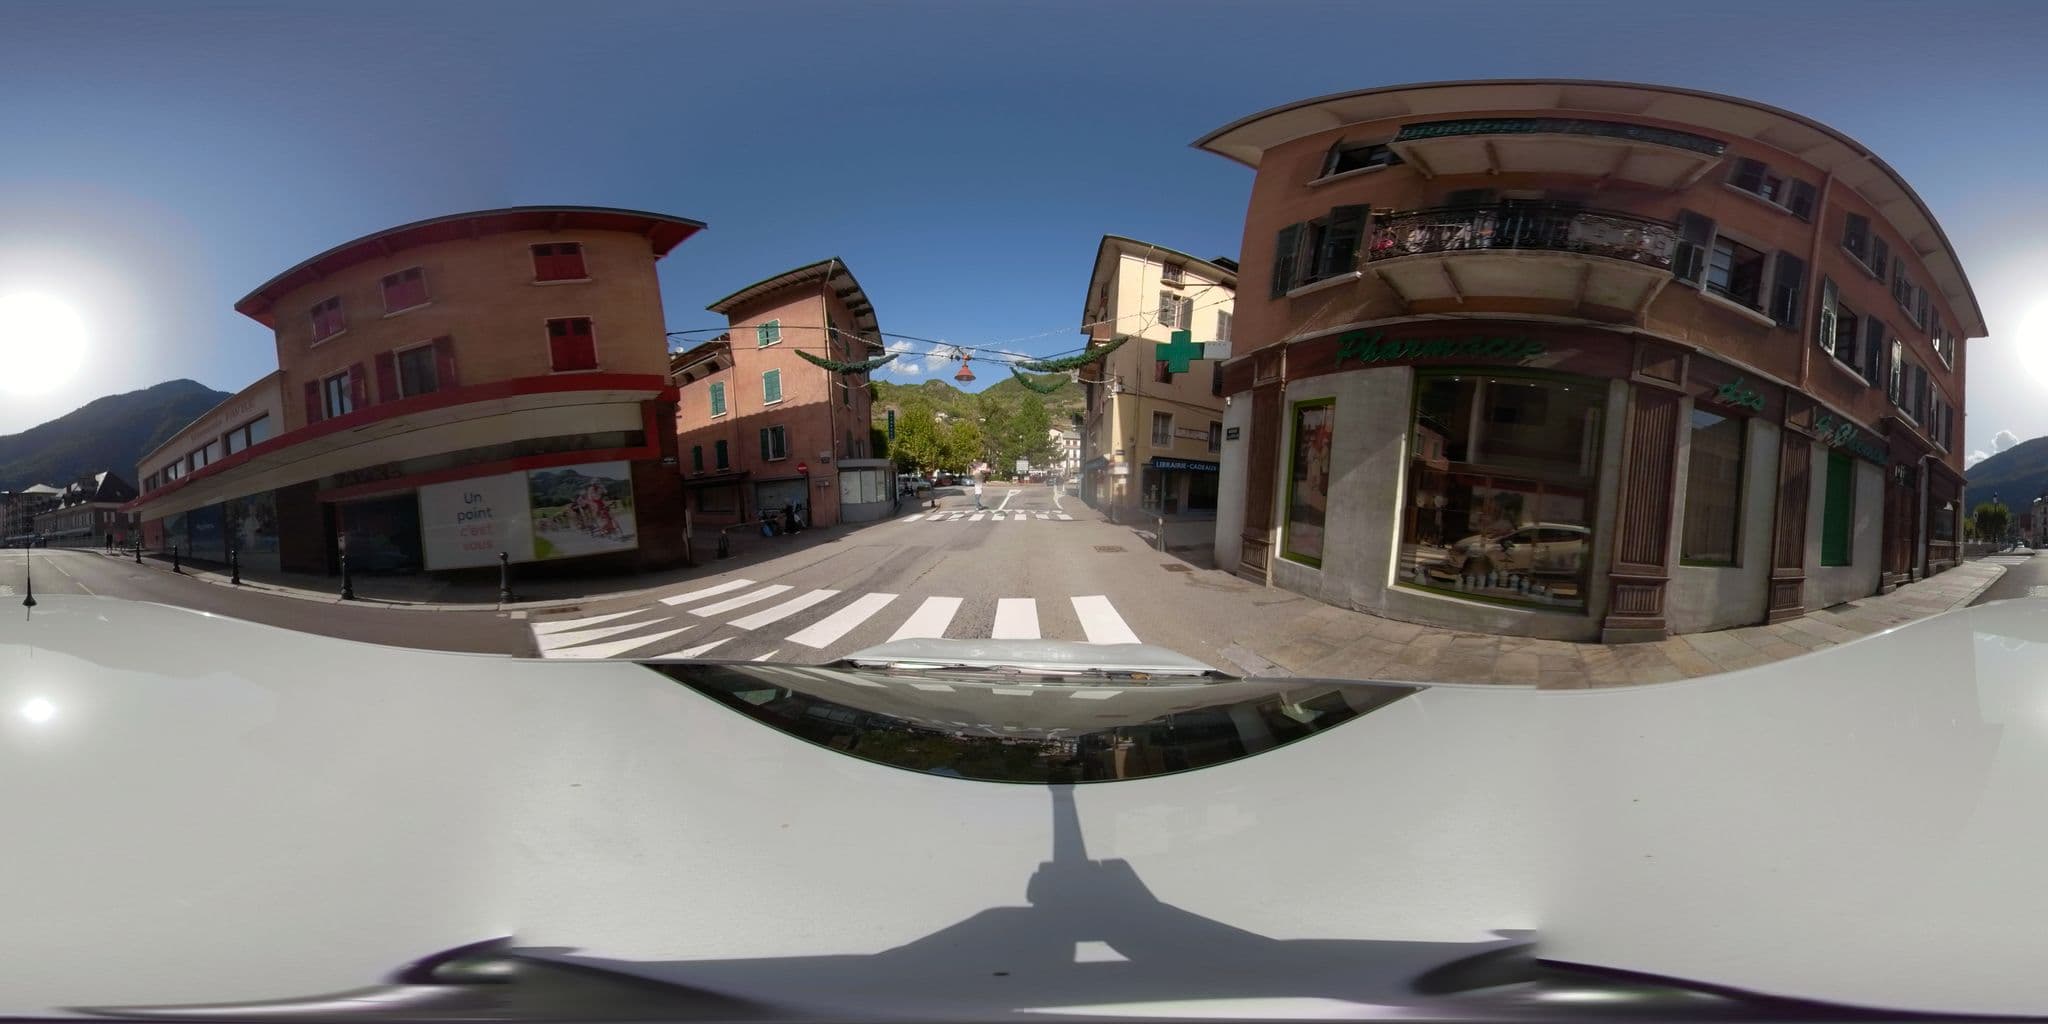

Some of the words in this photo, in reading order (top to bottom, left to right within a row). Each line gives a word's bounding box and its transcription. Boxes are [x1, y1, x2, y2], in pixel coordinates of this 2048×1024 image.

[1335, 329, 1547, 368] Pharmacie
[1718, 376, 1766, 411] des
[464, 491, 482, 505] Un
[456, 507, 493, 525] point
